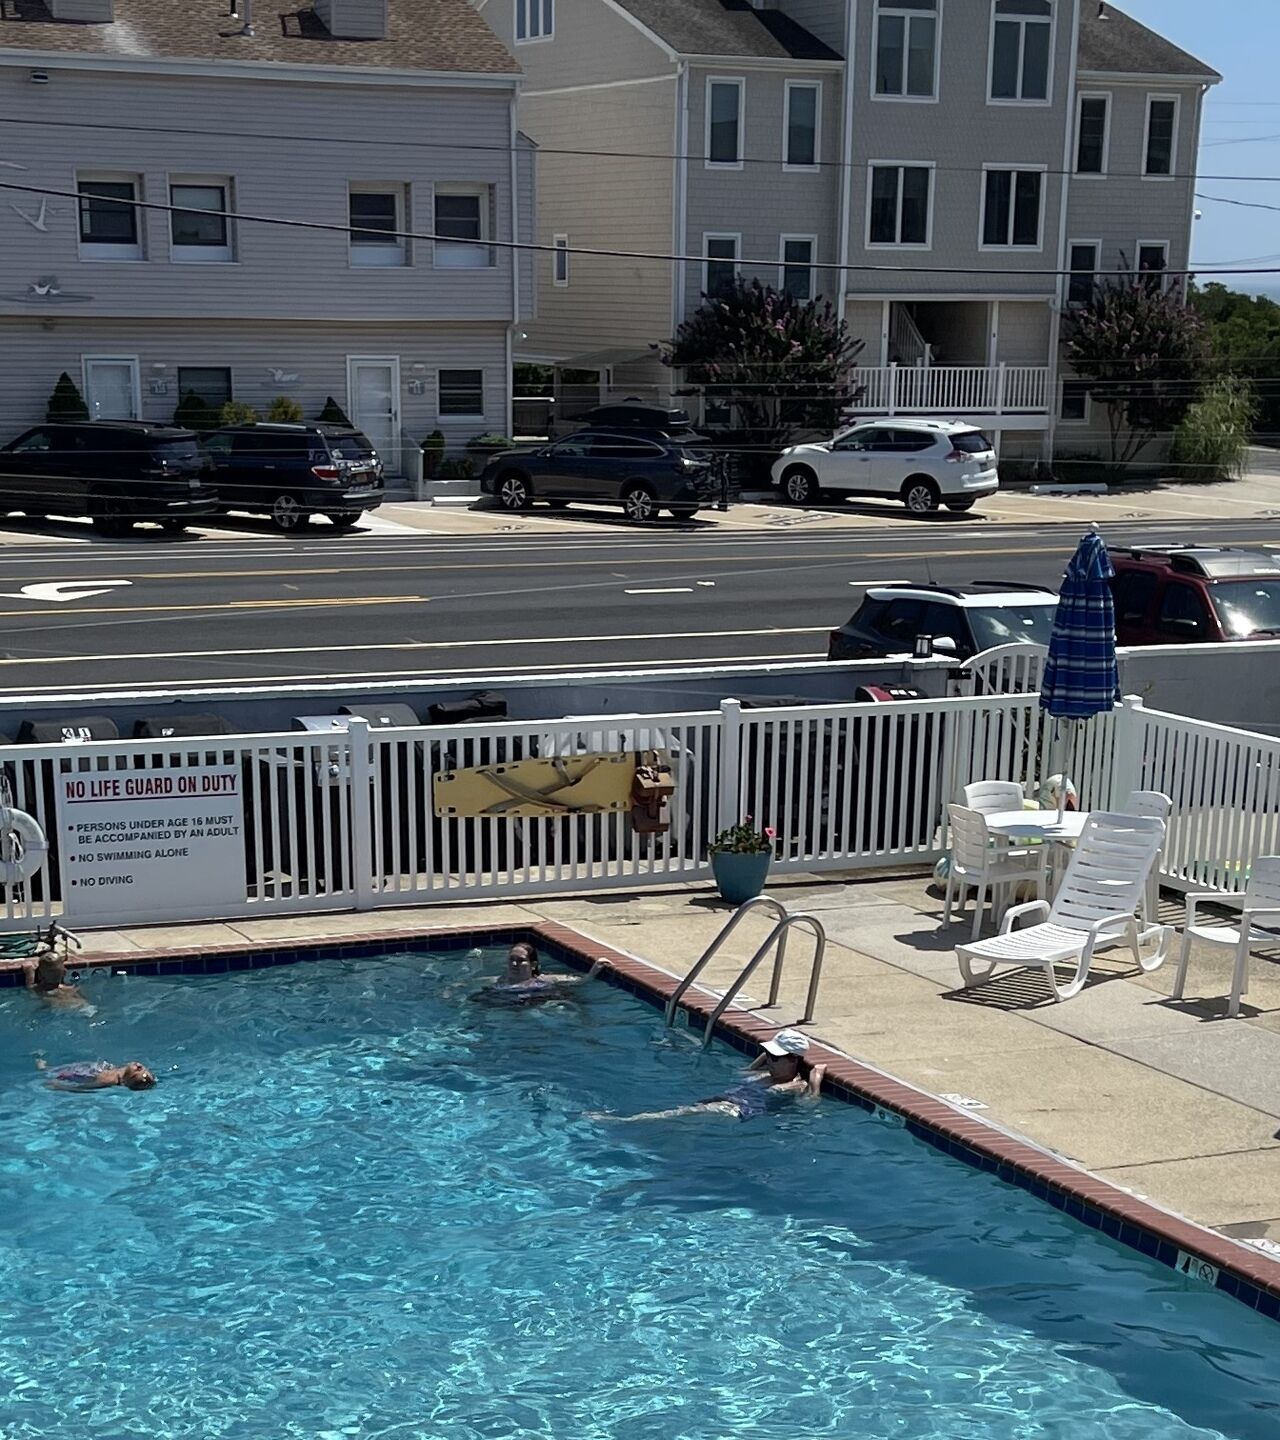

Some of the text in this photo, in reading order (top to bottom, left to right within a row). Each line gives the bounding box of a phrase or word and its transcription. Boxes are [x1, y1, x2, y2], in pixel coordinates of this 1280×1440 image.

[66, 774, 237, 798] NO LIFE GUARD ON DUTY
[76, 815, 233, 833] PERSONS UNDER AGE 16 MUST
[78, 826, 240, 845] BE ACCOMPANIED BY AN ADULT
[78, 847, 189, 863] NO SWIMMING ALONE
[80, 875, 134, 887] NO DIVING
